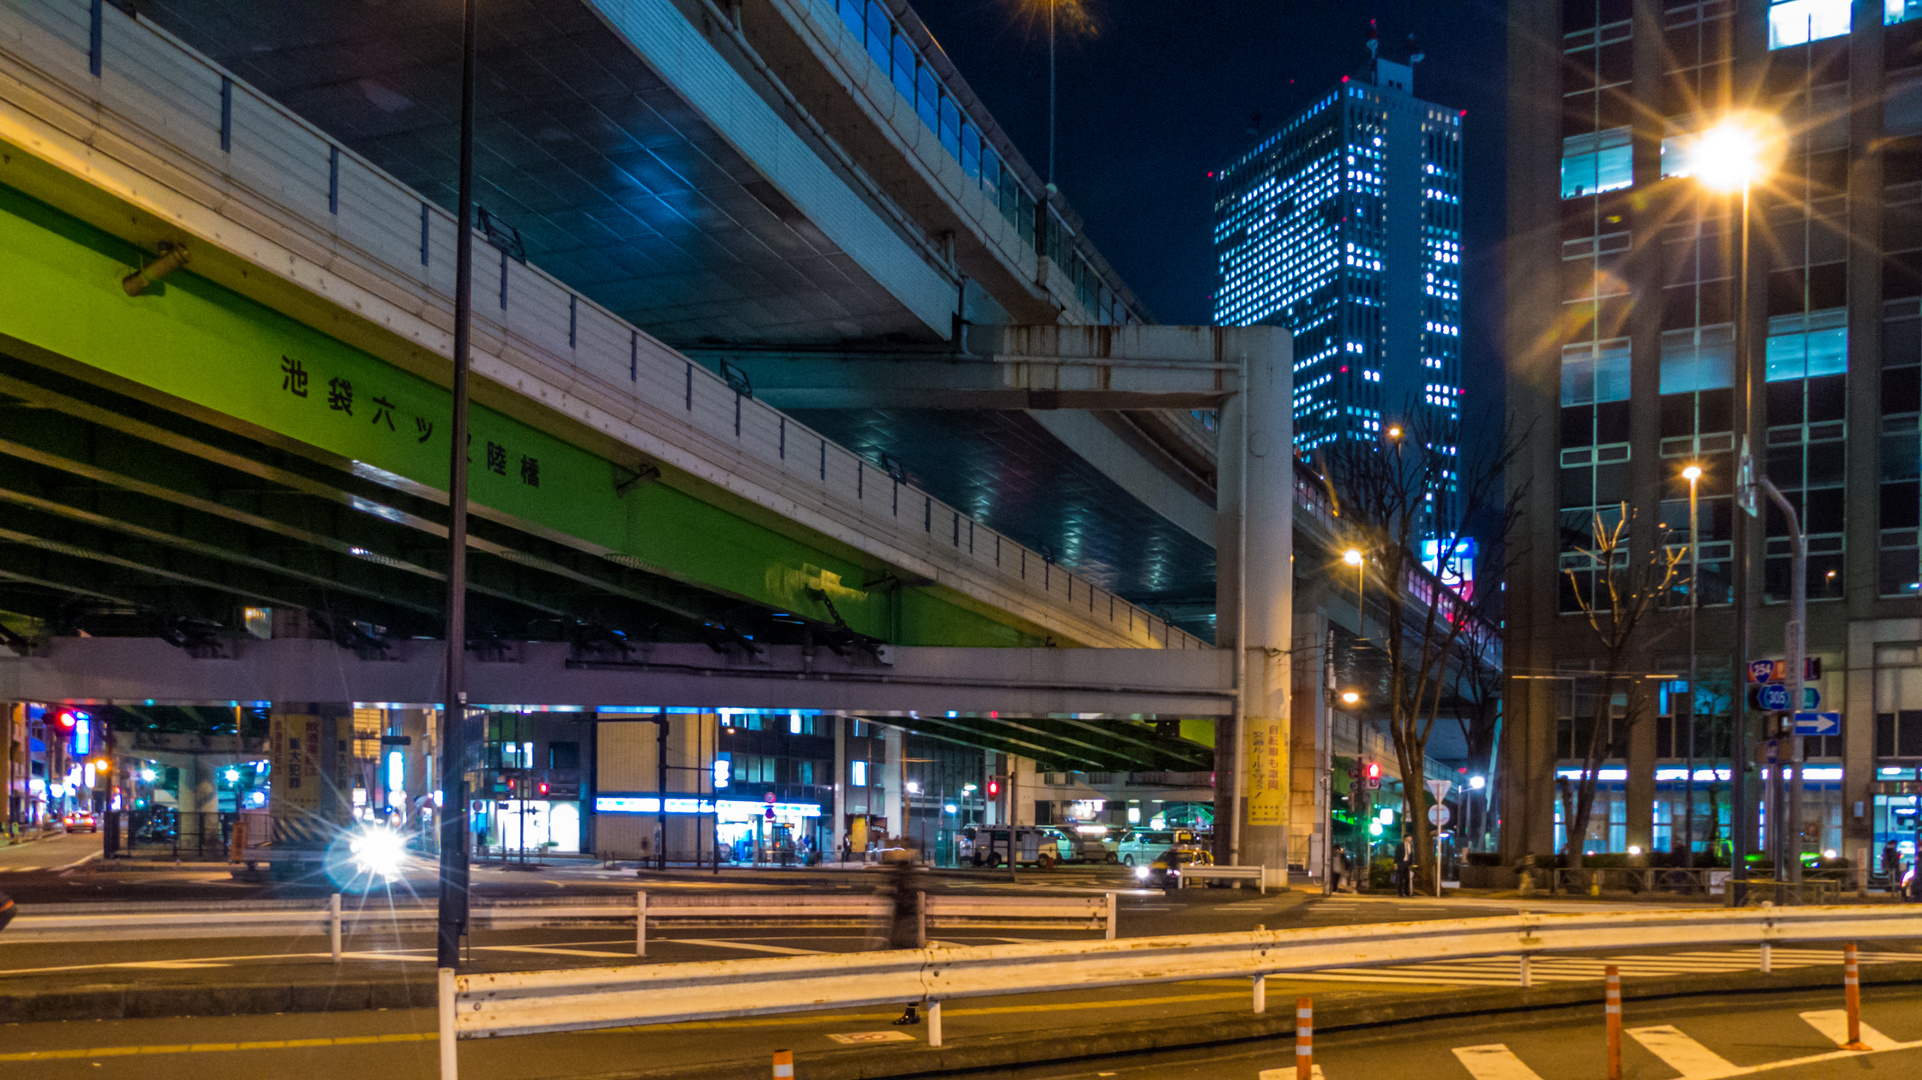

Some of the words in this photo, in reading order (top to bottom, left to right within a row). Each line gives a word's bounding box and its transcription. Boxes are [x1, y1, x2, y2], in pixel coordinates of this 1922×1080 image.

[281, 355, 540, 489] 池袋六ツ陸橋
[1754, 662, 1771, 676] 254
[1768, 691, 1786, 704] 305
